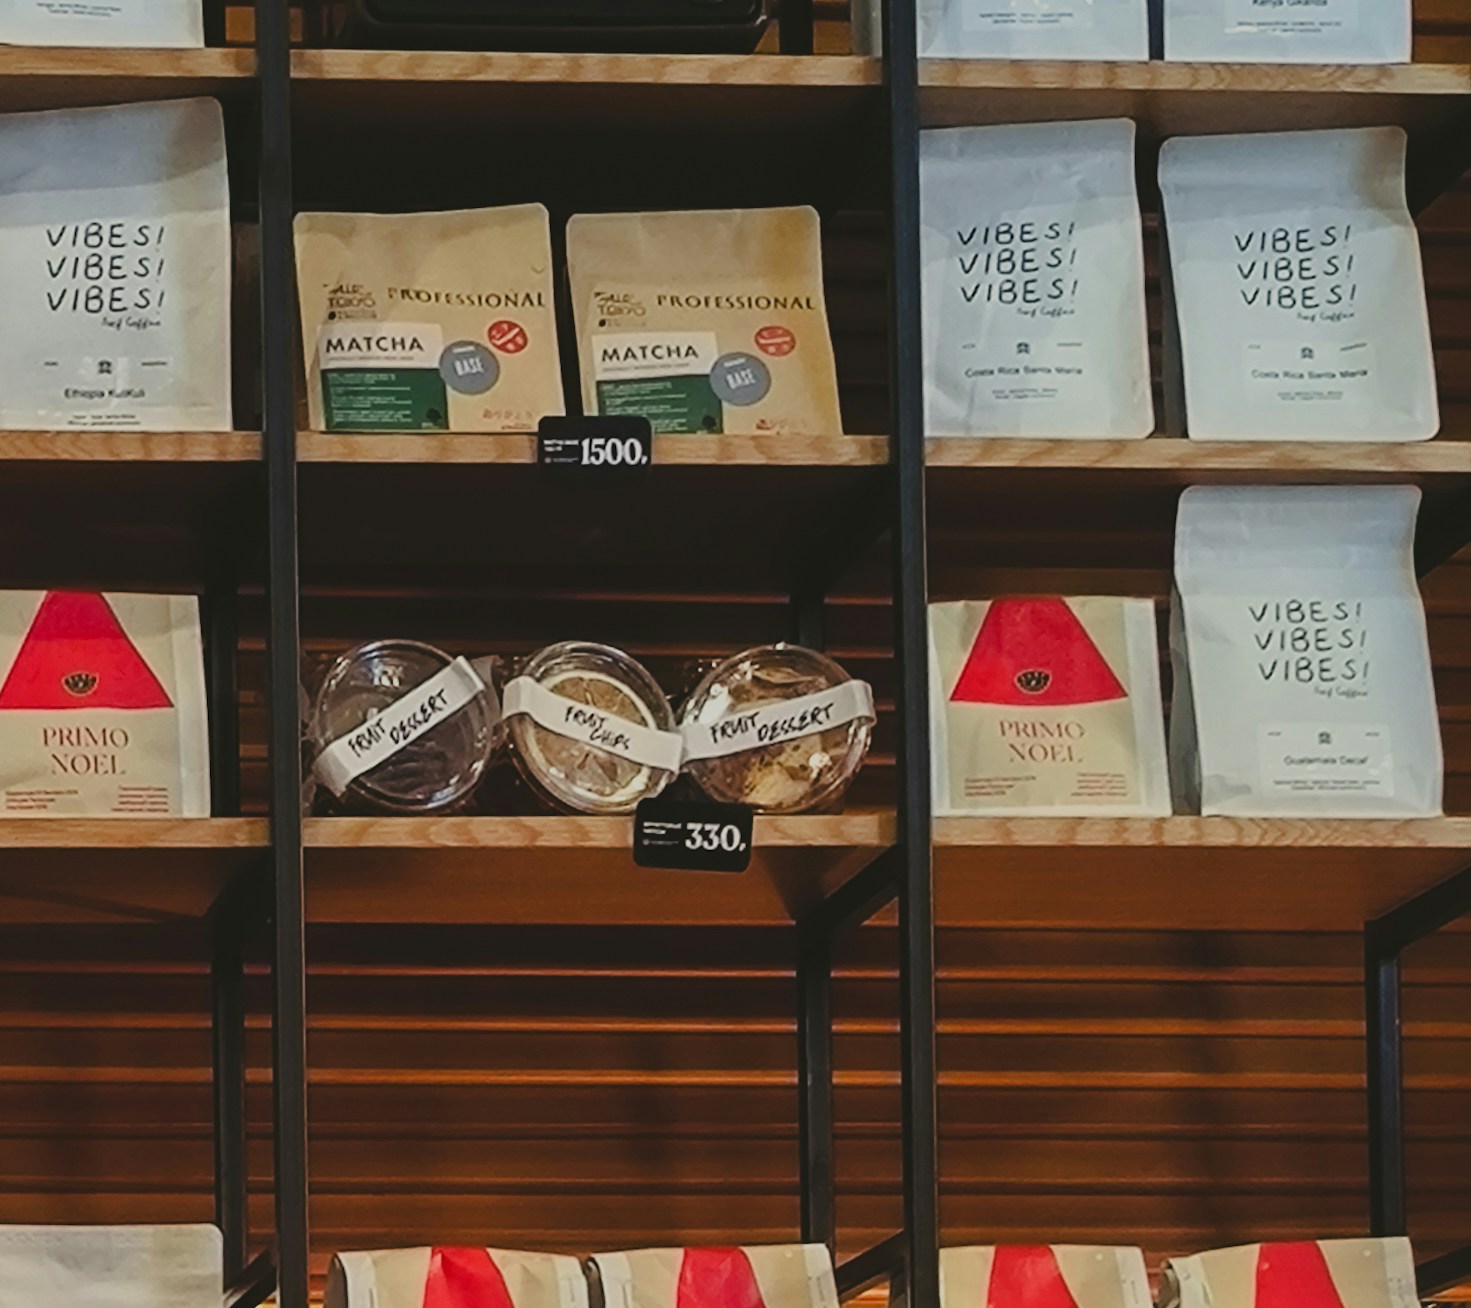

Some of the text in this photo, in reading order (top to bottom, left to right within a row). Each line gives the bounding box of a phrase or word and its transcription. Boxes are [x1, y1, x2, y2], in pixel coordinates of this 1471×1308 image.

[46, 222, 164, 253] VIBES!
[957, 222, 1075, 246] VIBES!
[1234, 225, 1351, 253] VIBES!
[46, 253, 165, 283] VIBES!
[959, 248, 1077, 275] VIBES!
[1237, 255, 1354, 282] VIBES!
[47, 285, 165, 315] VIBES!
[387, 287, 546, 308] PROFESSIONAL
[657, 295, 817, 311] PROFESSIONAL
[961, 278, 1078, 304] VIBES!
[1241, 284, 1357, 310] VIBES!
[325, 336, 425, 353] MATCHA
[601, 345, 700, 363] MATCHA
[1248, 599, 1362, 624] VIBES!
[1254, 626, 1367, 655] VIBES!
[1258, 656, 1370, 686] VIBES!
[389, 688, 448, 745] DESSERT
[710, 711, 760, 744] FRUIT
[757, 702, 835, 743] DESSERT
[999, 720, 1086, 739] PRIMO
[42, 727, 129, 748] PRIMO
[348, 717, 386, 758] FRUIT
[51, 753, 127, 775] NOEL
[1008, 743, 1084, 763] NOEL
